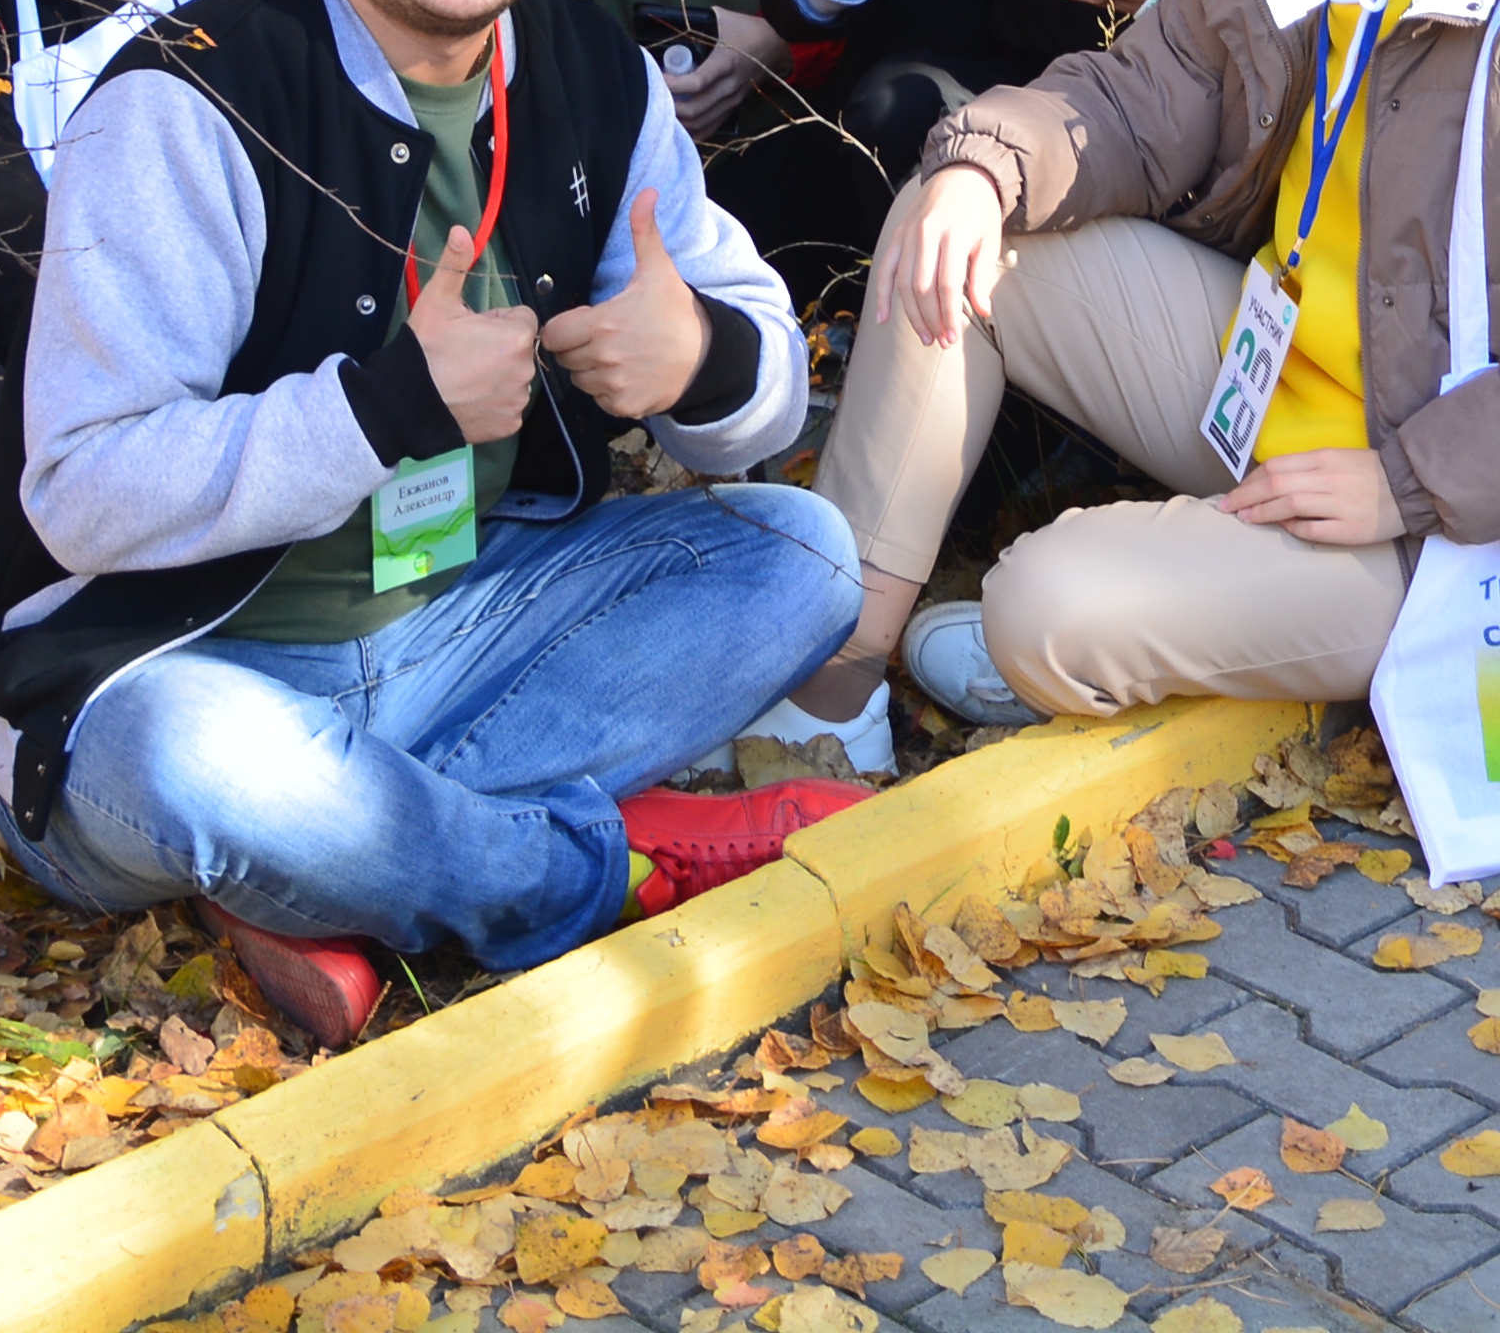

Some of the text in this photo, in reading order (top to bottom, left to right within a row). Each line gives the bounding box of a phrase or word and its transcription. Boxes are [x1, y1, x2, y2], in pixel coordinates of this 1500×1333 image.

[1247, 294, 1285, 348] УЧАСТНИК
[397, 475, 449, 500] Екжанов
[393, 489, 456, 517] Александр
